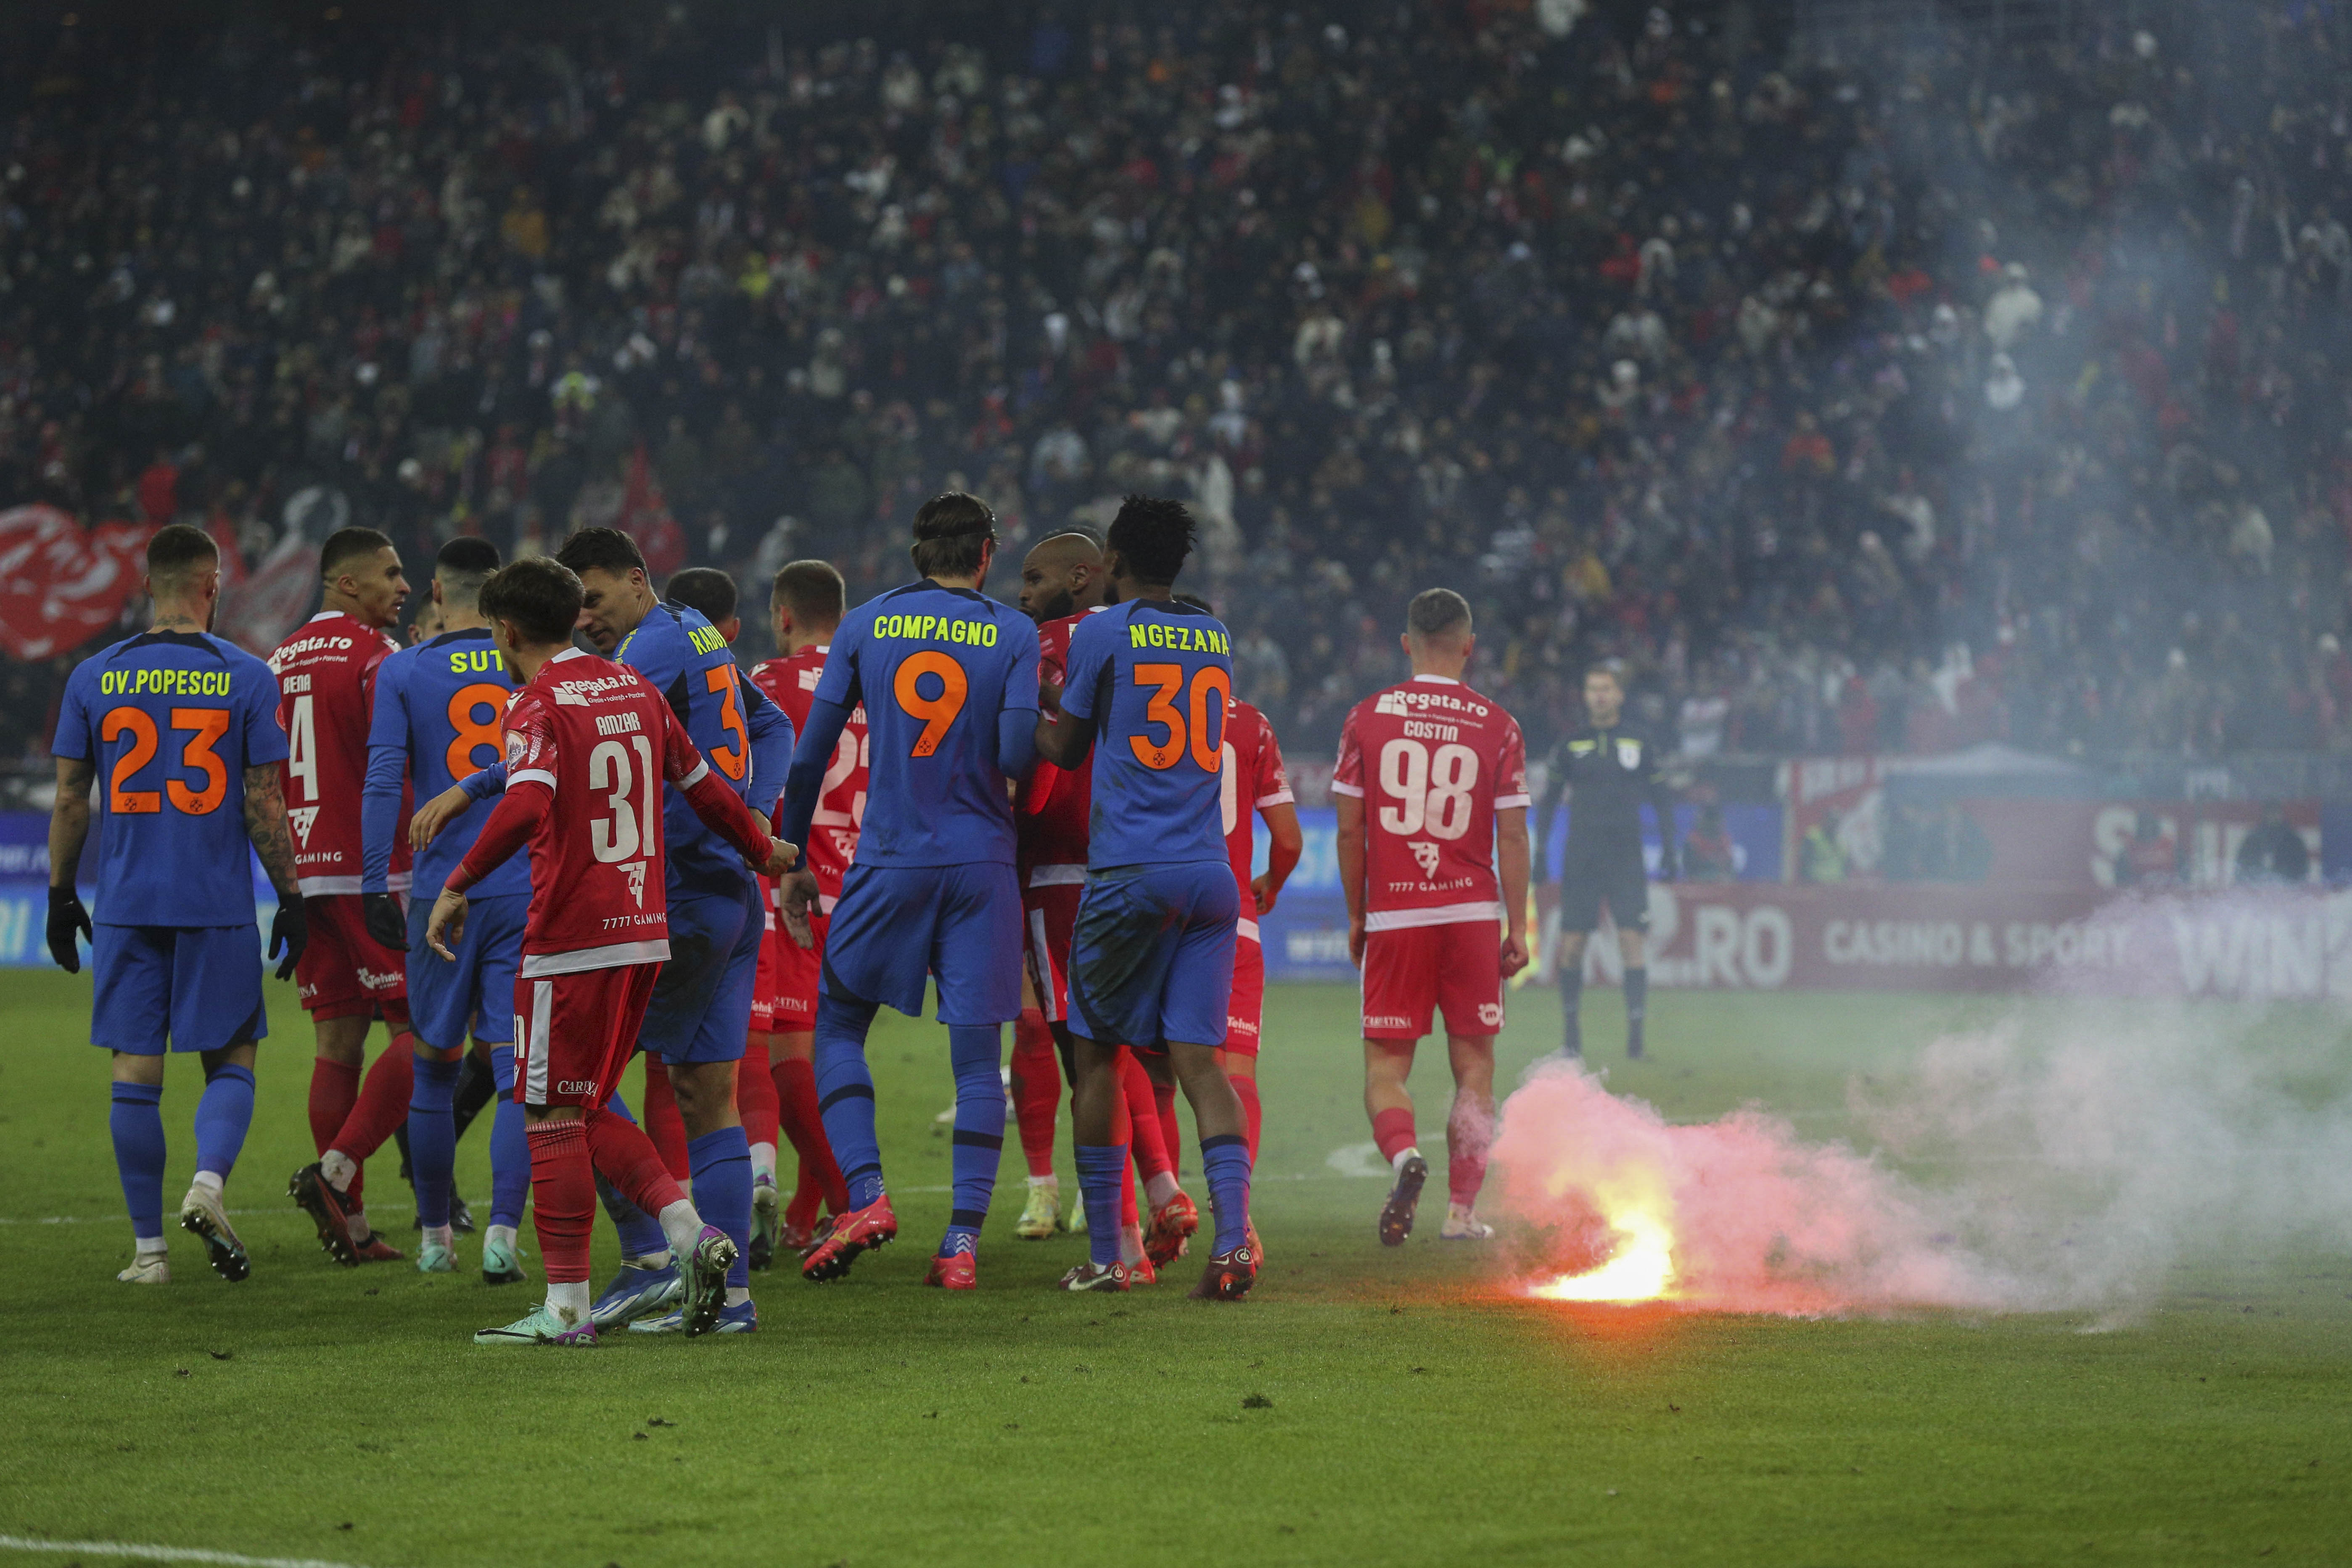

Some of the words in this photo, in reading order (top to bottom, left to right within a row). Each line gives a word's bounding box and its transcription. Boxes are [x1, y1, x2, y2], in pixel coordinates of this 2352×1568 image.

[874, 615, 998, 647] COMPAGNO
[1129, 624, 1230, 657] NGEZANA
[272, 636, 353, 663] Regata.ro
[450, 649, 504, 673] SUT
[101, 669, 230, 696] OV.POPESCU
[283, 673, 311, 694] BENA
[559, 674, 638, 697] Regata.ro
[893, 650, 967, 757] 9
[1393, 690, 1489, 717] Regata.ro
[595, 711, 642, 736] AMZAR
[1128, 662, 1230, 773] 30
[1403, 720, 1459, 742] COSTIN
[447, 683, 511, 783] 8
[102, 706, 230, 815] 23
[289, 695, 319, 801] 4
[589, 735, 655, 863] 31
[1379, 738, 1479, 840] 98
[295, 851, 342, 865] GAMING
[1388, 881, 1414, 892] 7777
[1418, 876, 1473, 892] GAMING
[603, 916, 631, 930] 7777
[634, 912, 666, 925] GAMING
[1823, 920, 1964, 965] CASINO
[2006, 921, 2128, 967] SPORT
